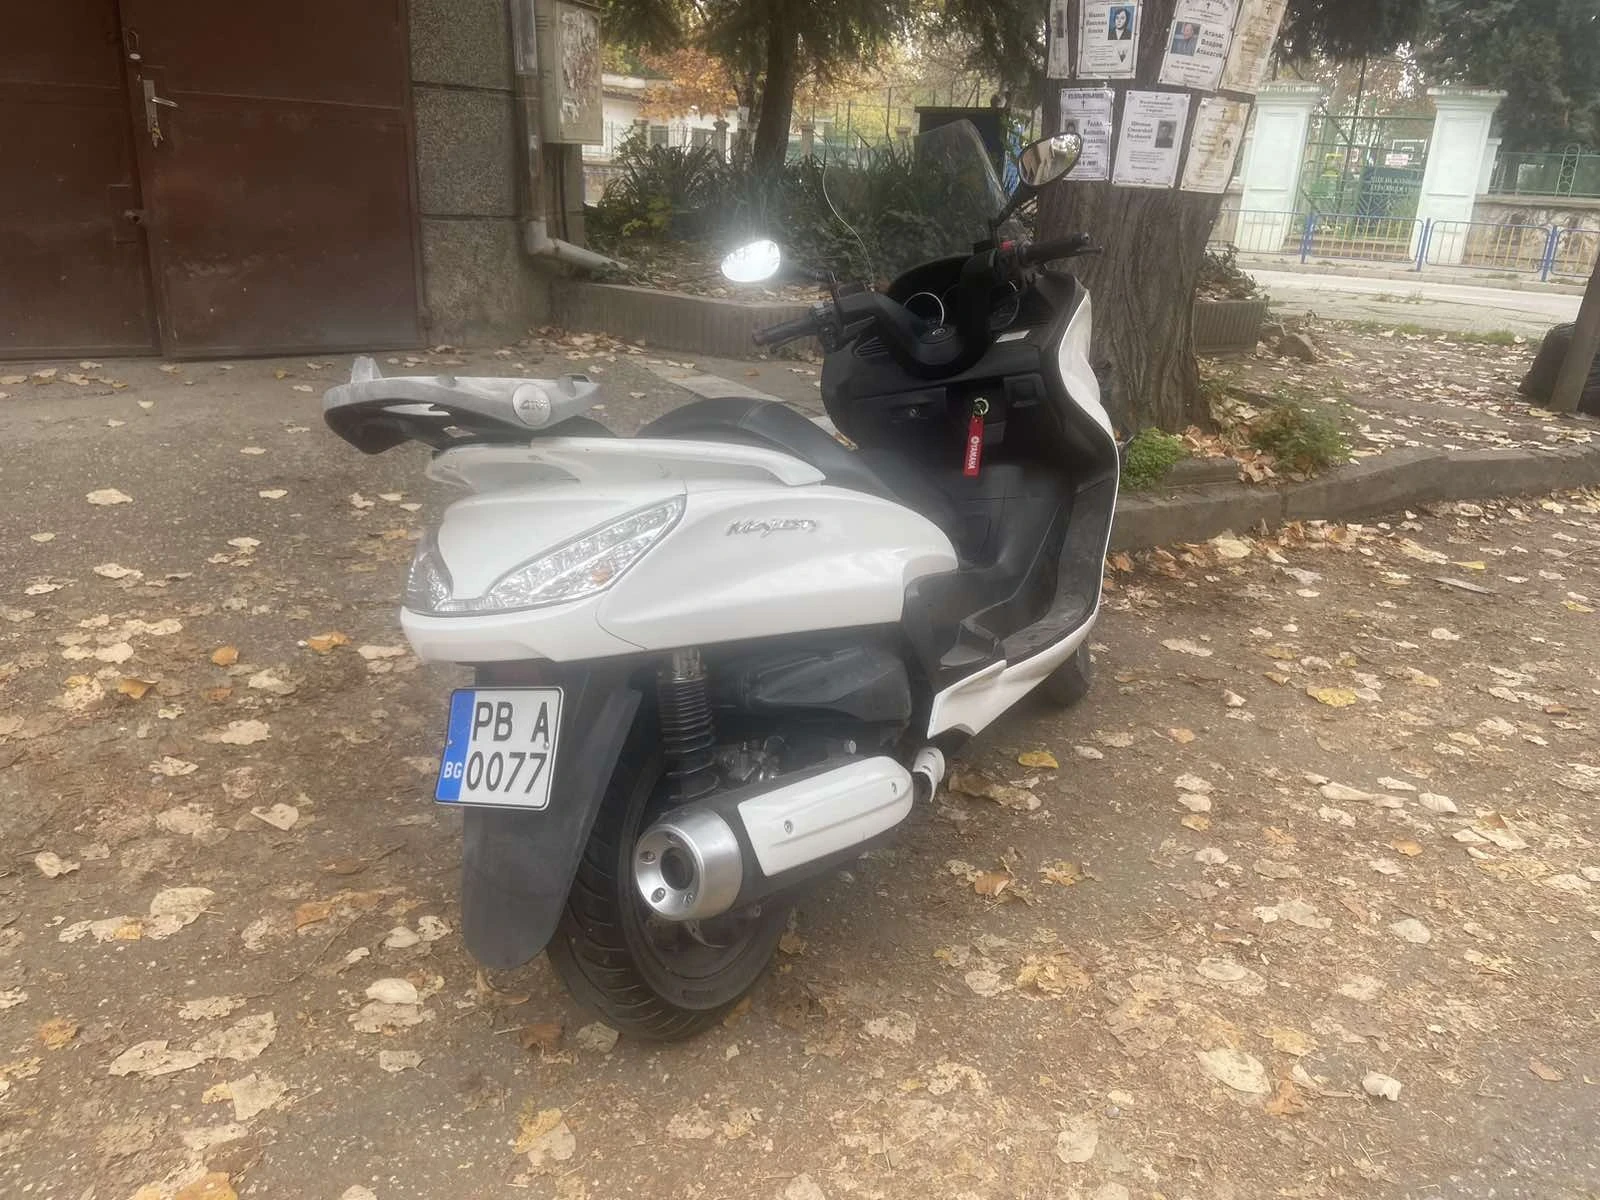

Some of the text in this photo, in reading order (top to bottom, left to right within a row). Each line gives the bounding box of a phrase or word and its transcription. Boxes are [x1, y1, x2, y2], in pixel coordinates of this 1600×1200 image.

[967, 443, 978, 470] YAMAHA
[472, 701, 550, 743] PB A
[443, 761, 463, 779] BG
[466, 750, 548, 794] 0077
